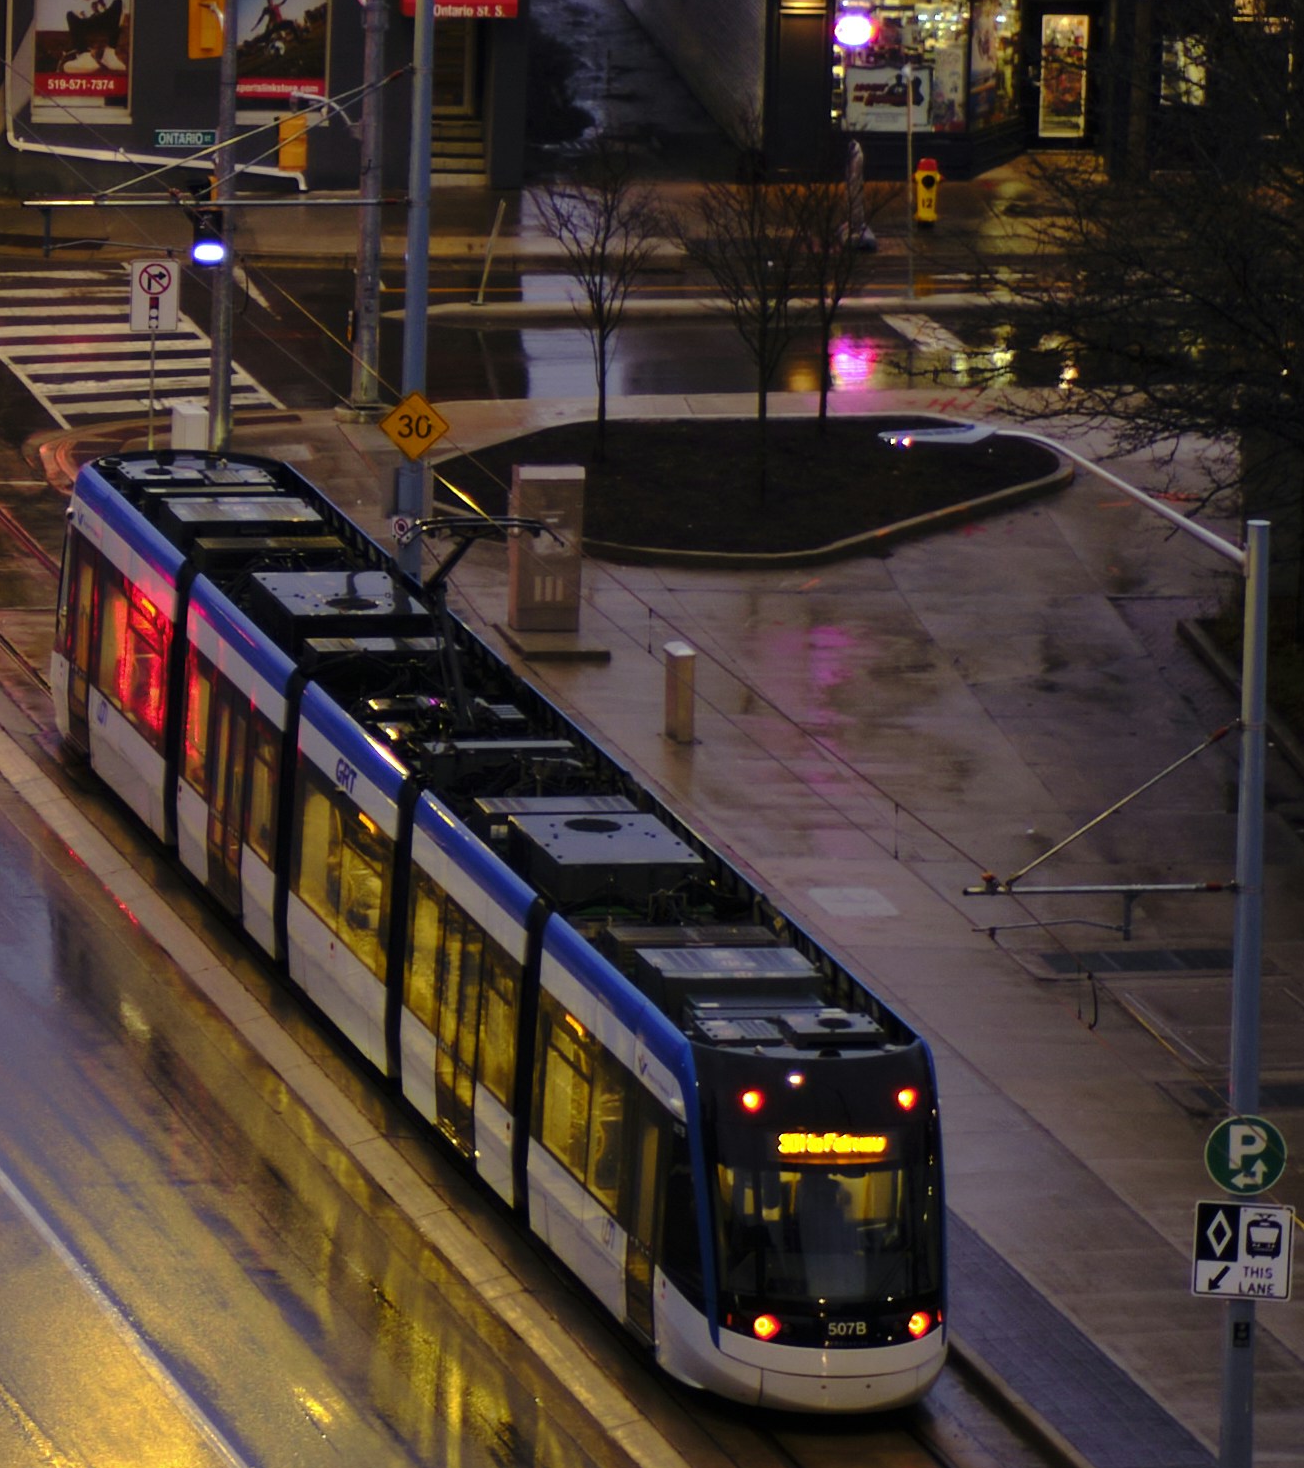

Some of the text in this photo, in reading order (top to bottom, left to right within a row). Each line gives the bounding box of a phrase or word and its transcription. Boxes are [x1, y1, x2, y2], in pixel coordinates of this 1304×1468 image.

[433, 3, 506, 18] Ontario St. S.
[47, 77, 115, 92] 519-571-7374
[158, 132, 204, 146] ONTARIO
[398, 414, 432, 439] 30
[336, 757, 358, 795] GRT
[1228, 1124, 1269, 1171] P
[1242, 1266, 1274, 1280] THIS
[1238, 1281, 1275, 1297] LANE
